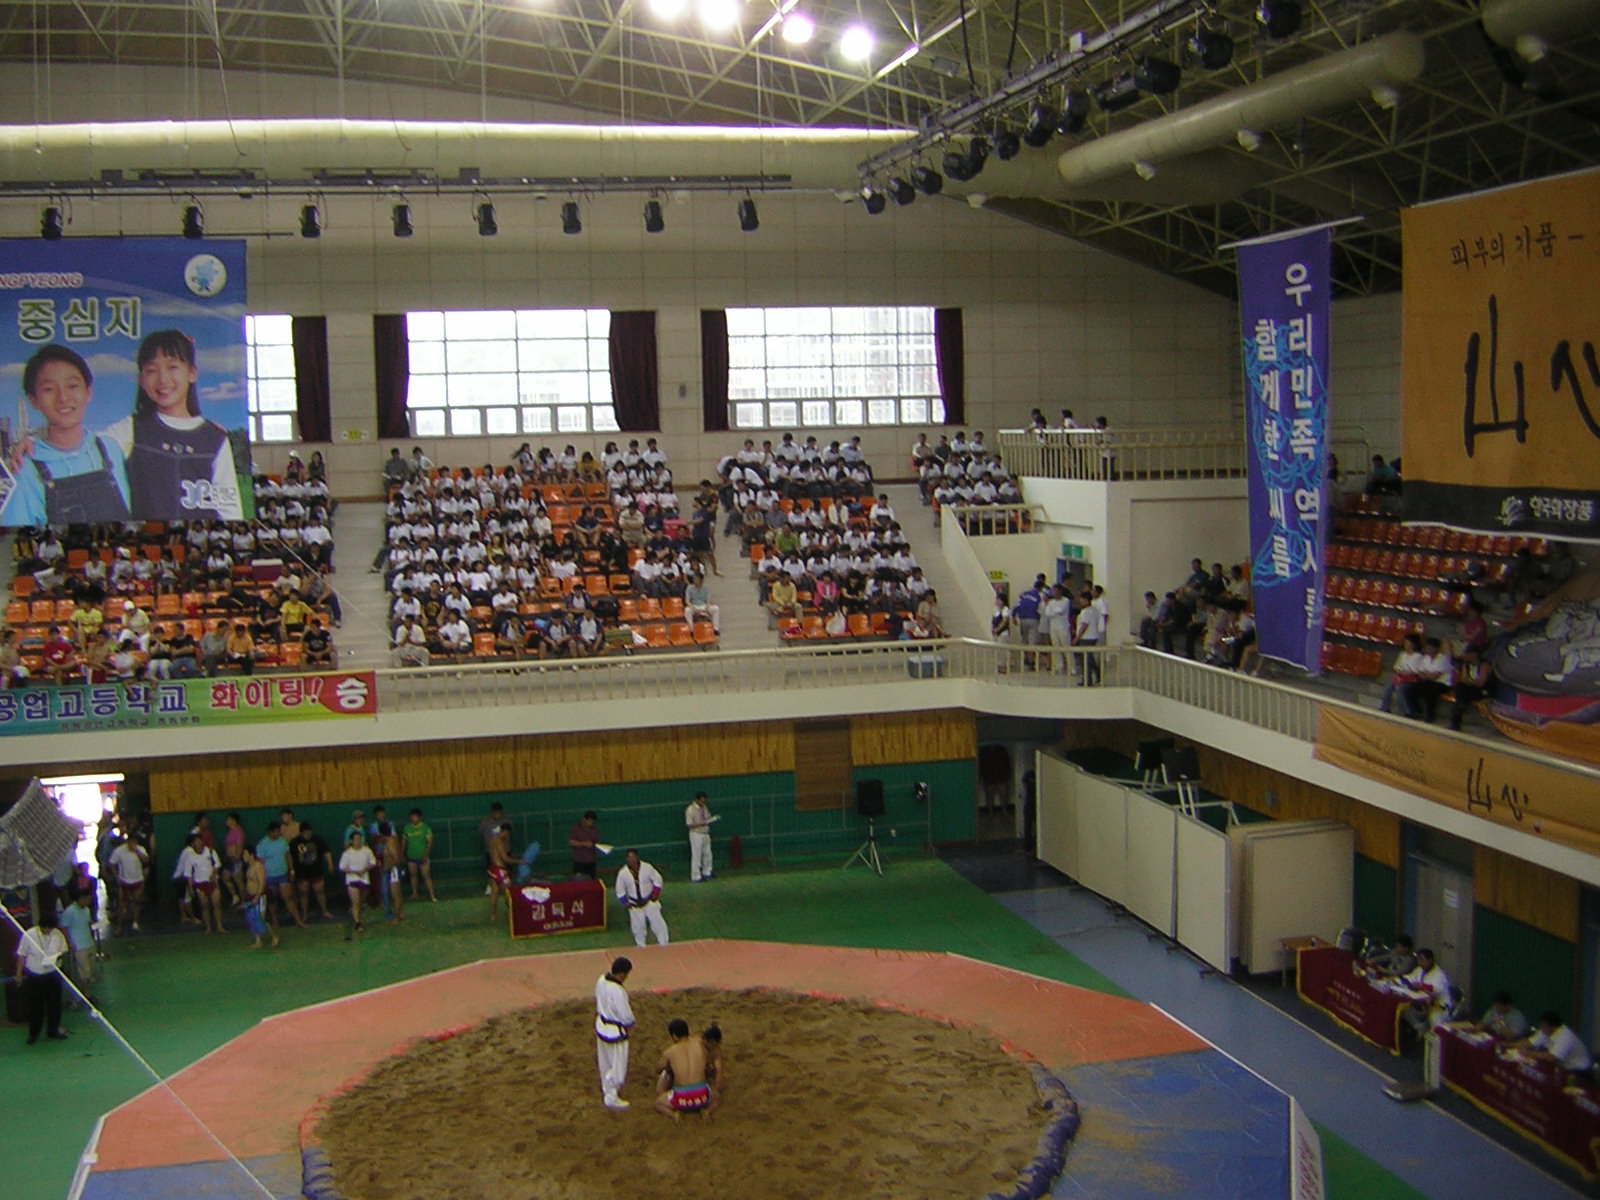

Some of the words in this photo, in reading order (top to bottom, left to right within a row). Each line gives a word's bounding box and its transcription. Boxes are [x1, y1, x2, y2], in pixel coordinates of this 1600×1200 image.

[1514, 222, 1558, 259] 기품
[18, 296, 143, 344] 중심지
[1284, 262, 1316, 461] 우리민족
[1268, 487, 1292, 578] 씨름
